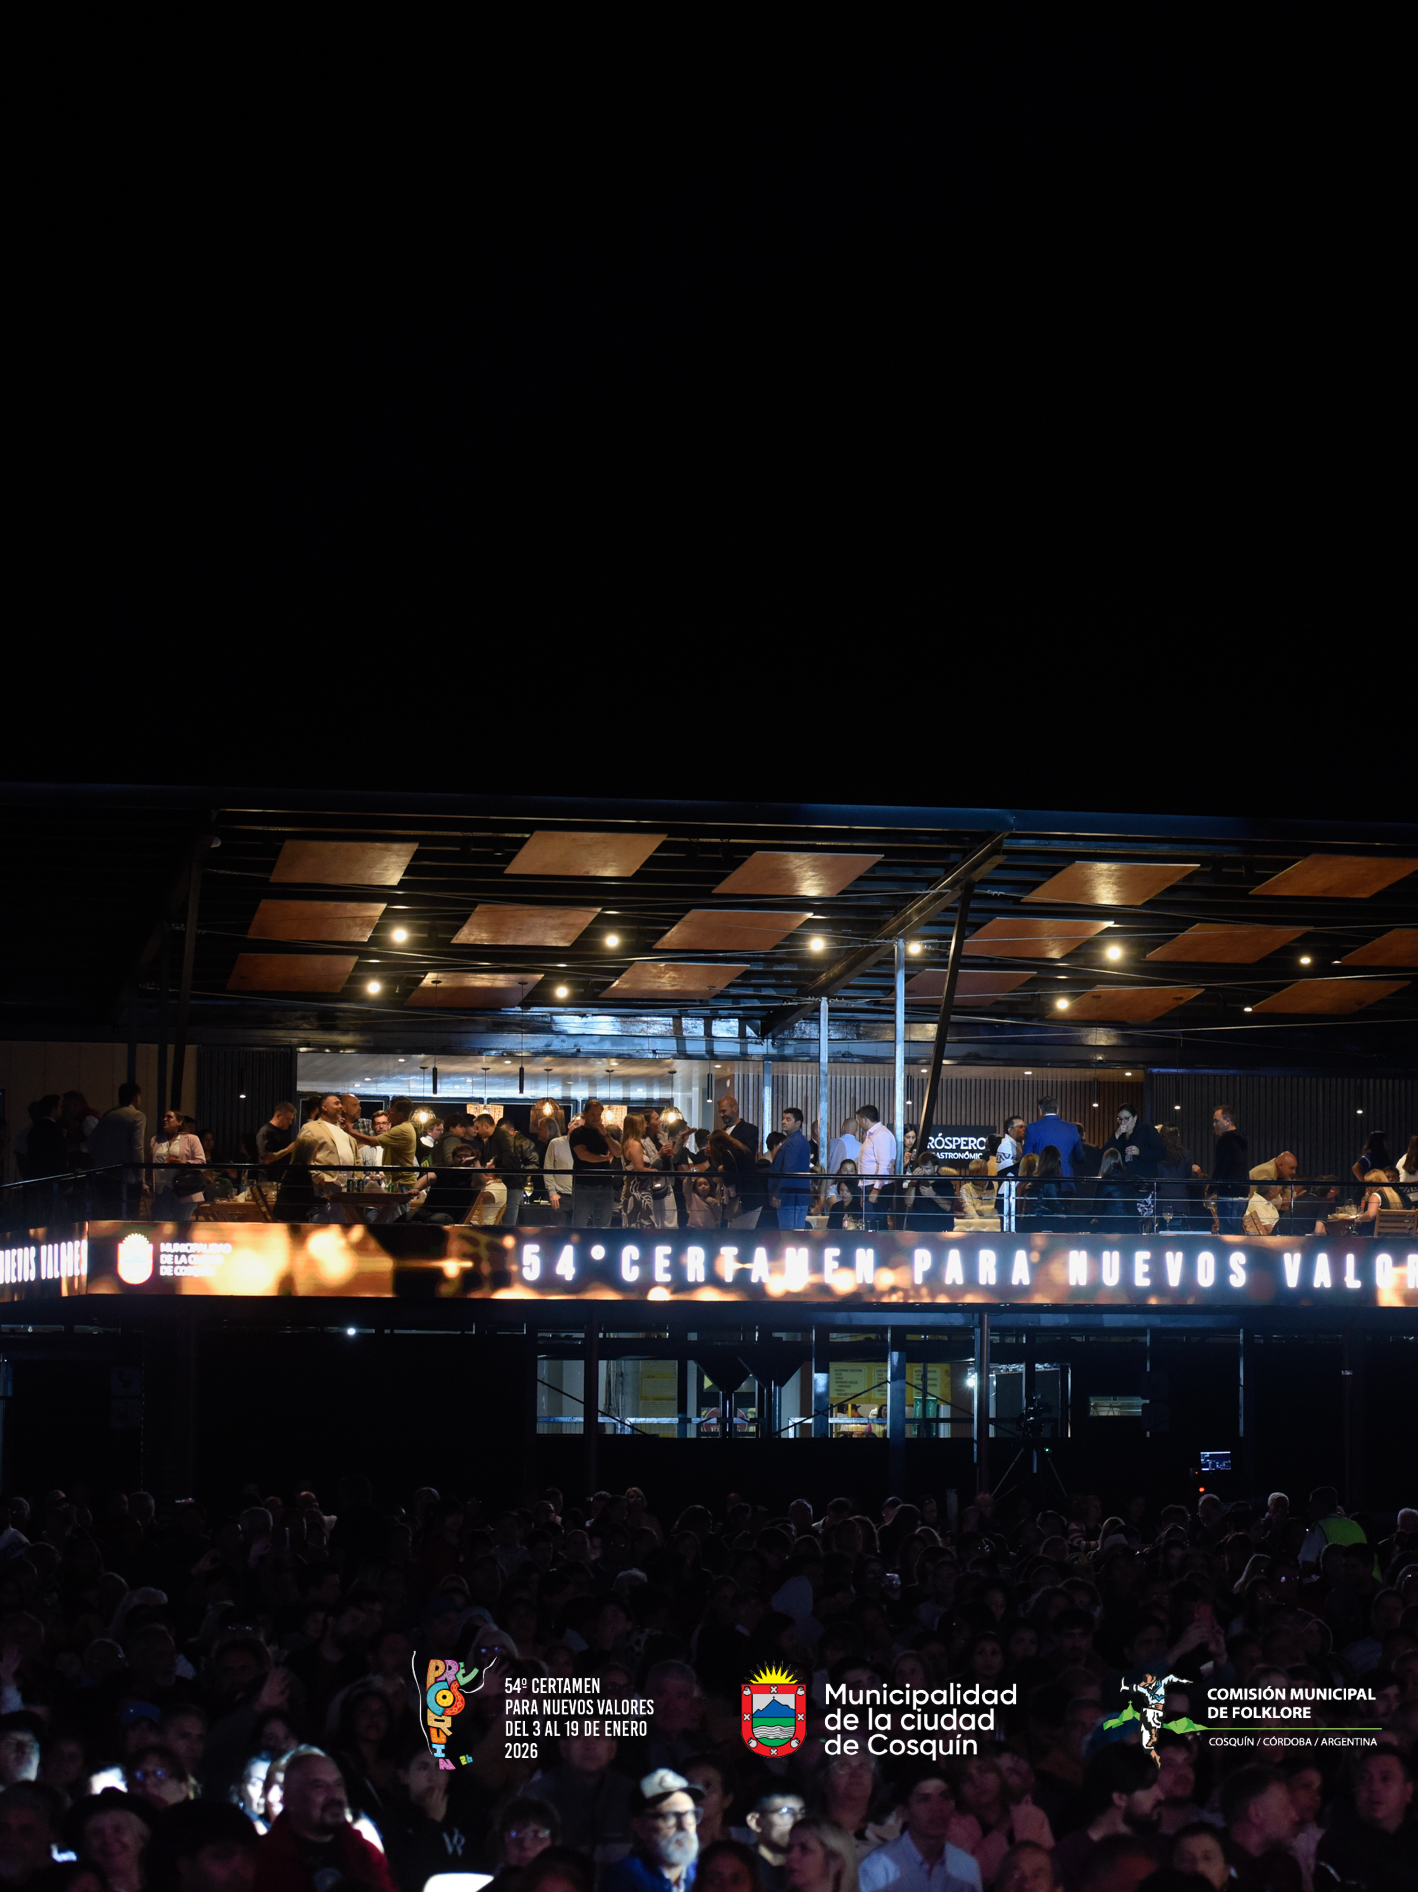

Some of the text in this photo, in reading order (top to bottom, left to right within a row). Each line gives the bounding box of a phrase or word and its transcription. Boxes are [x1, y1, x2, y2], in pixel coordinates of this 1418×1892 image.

[160, 1254, 174, 1265] DE
[174, 1254, 188, 1265] LA
[160, 1265, 174, 1276] DE
[913, 1248, 1031, 1285] PARA
[1068, 1250, 1247, 1288] NUEVOS
